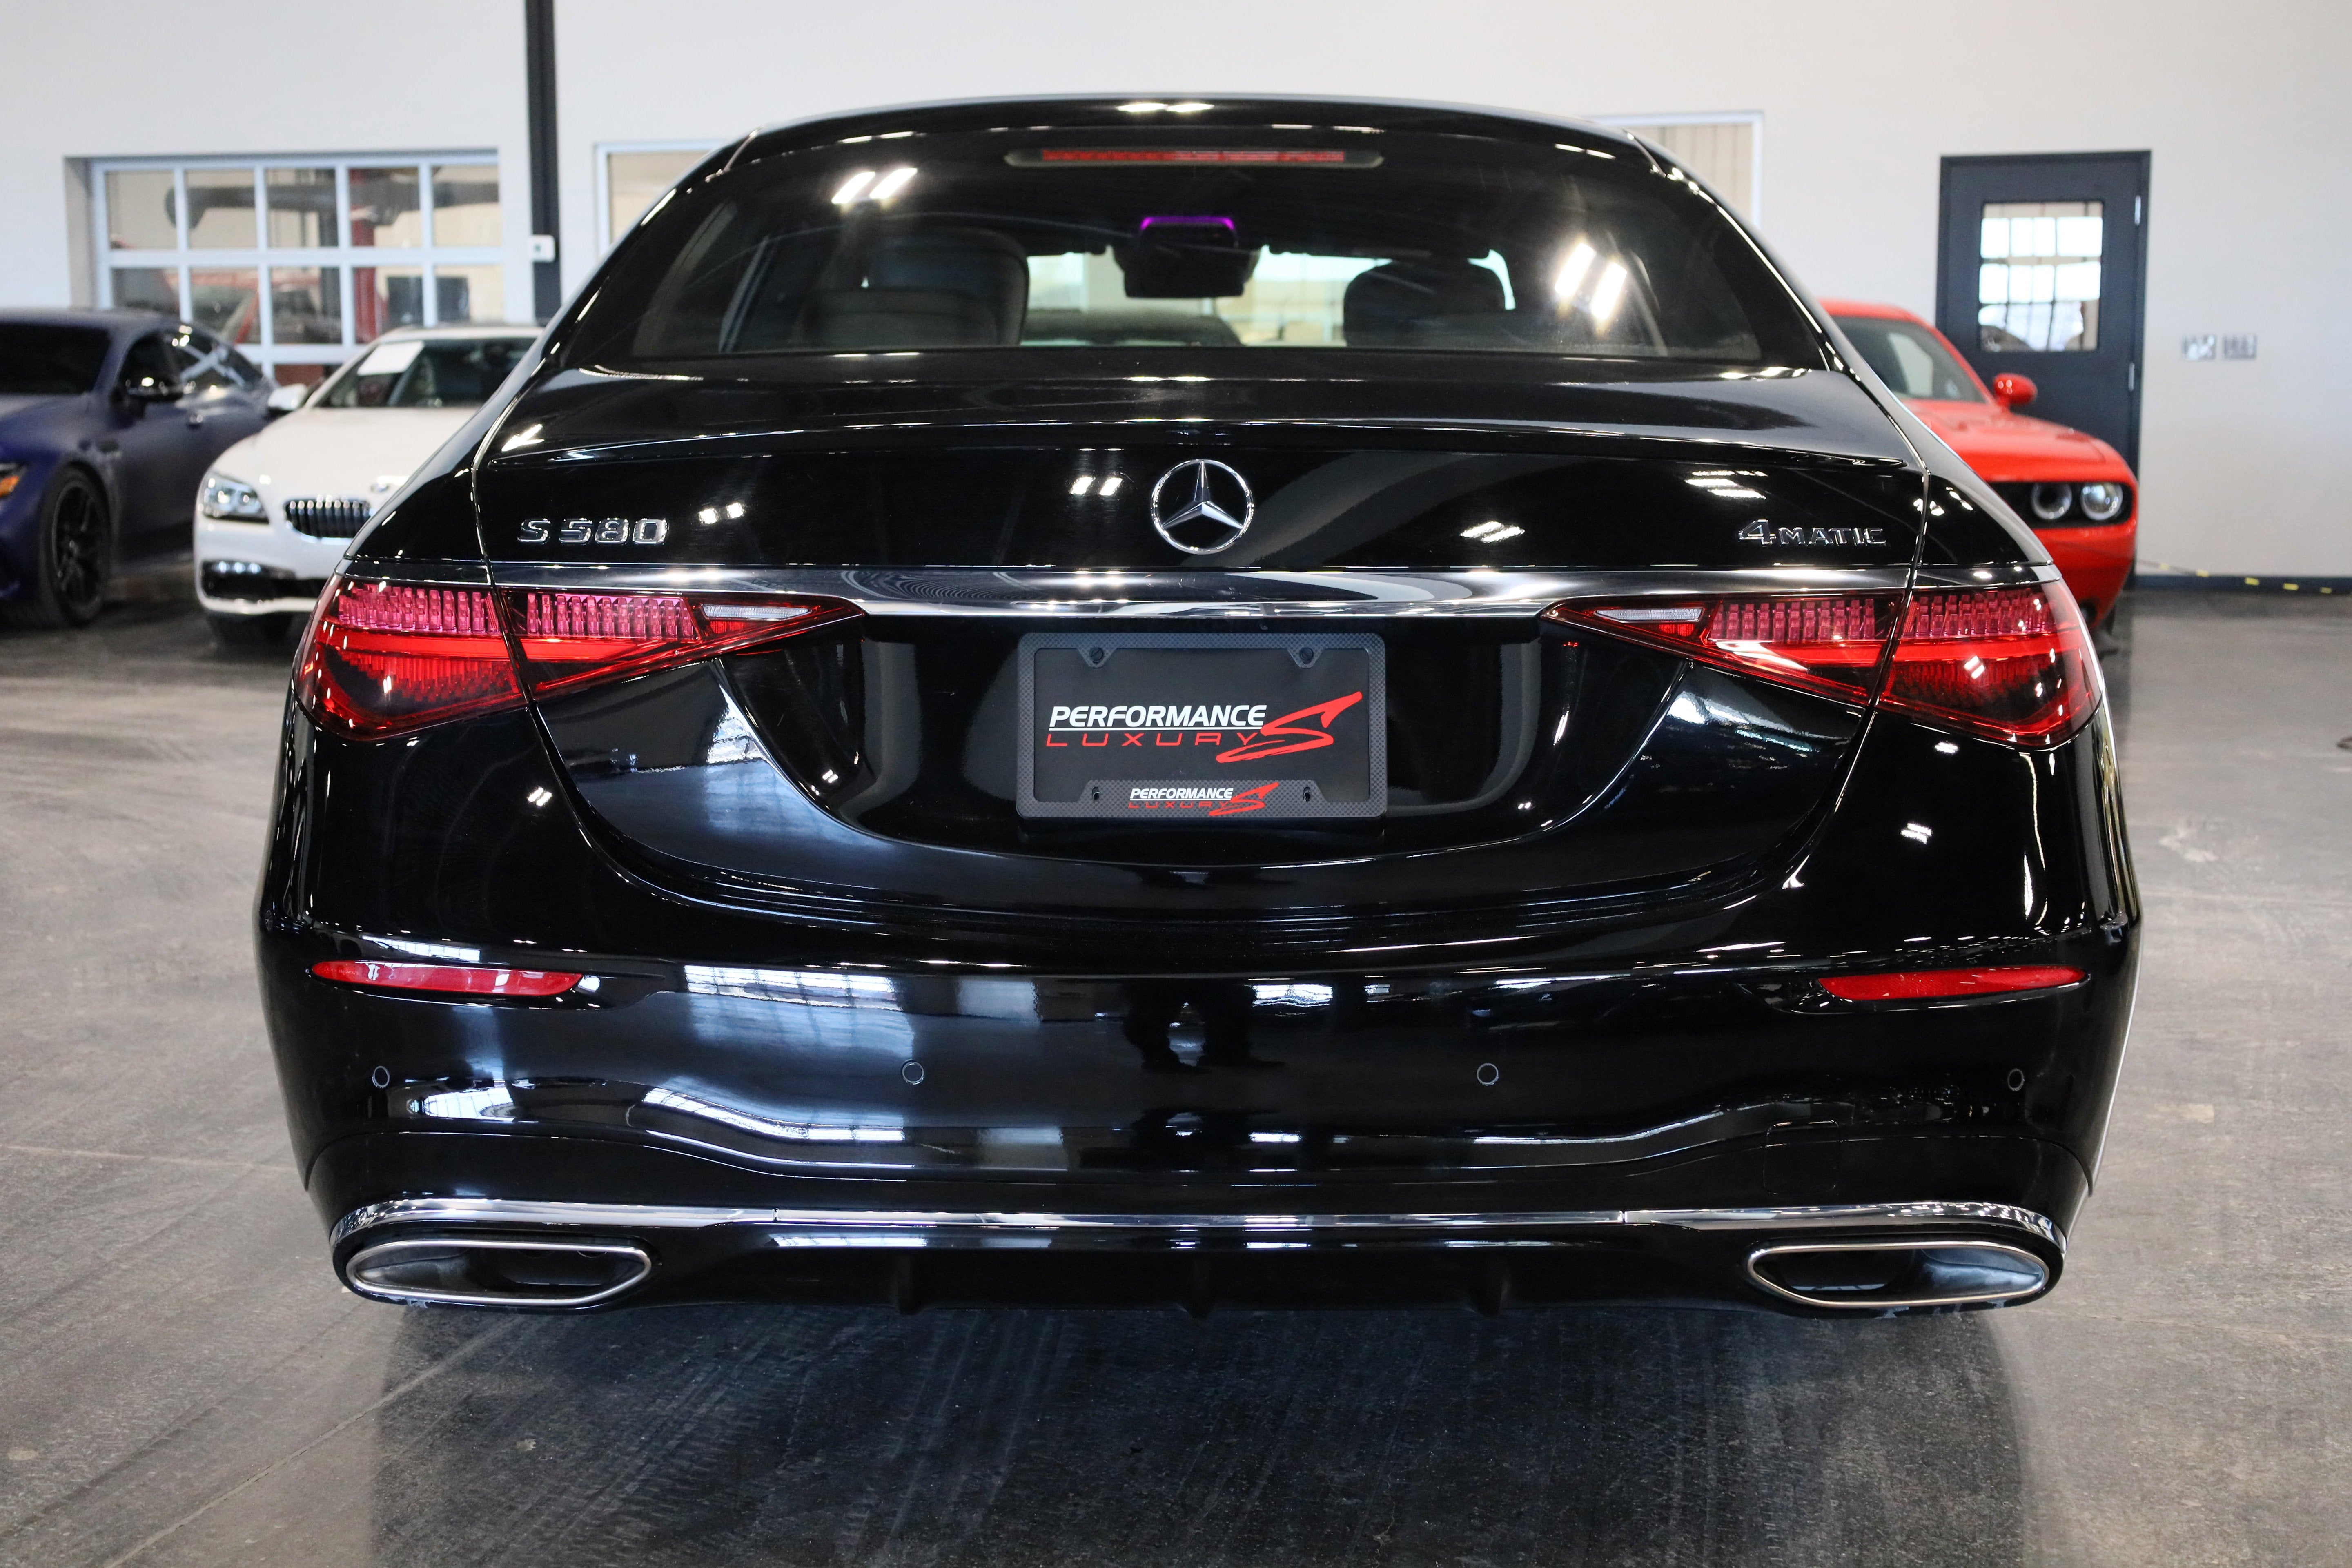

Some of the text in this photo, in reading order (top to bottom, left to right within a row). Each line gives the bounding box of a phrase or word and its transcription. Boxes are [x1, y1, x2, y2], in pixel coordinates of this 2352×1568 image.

[517, 517, 669, 545] S 580
[1738, 519, 1887, 546] 4MATIC
[1049, 705, 1267, 727] PERFORMANCE
[1046, 732, 1258, 747] LUXURY
[1130, 788, 1234, 799] PERFORMANCE
[1128, 801, 1230, 809] LUXURY
